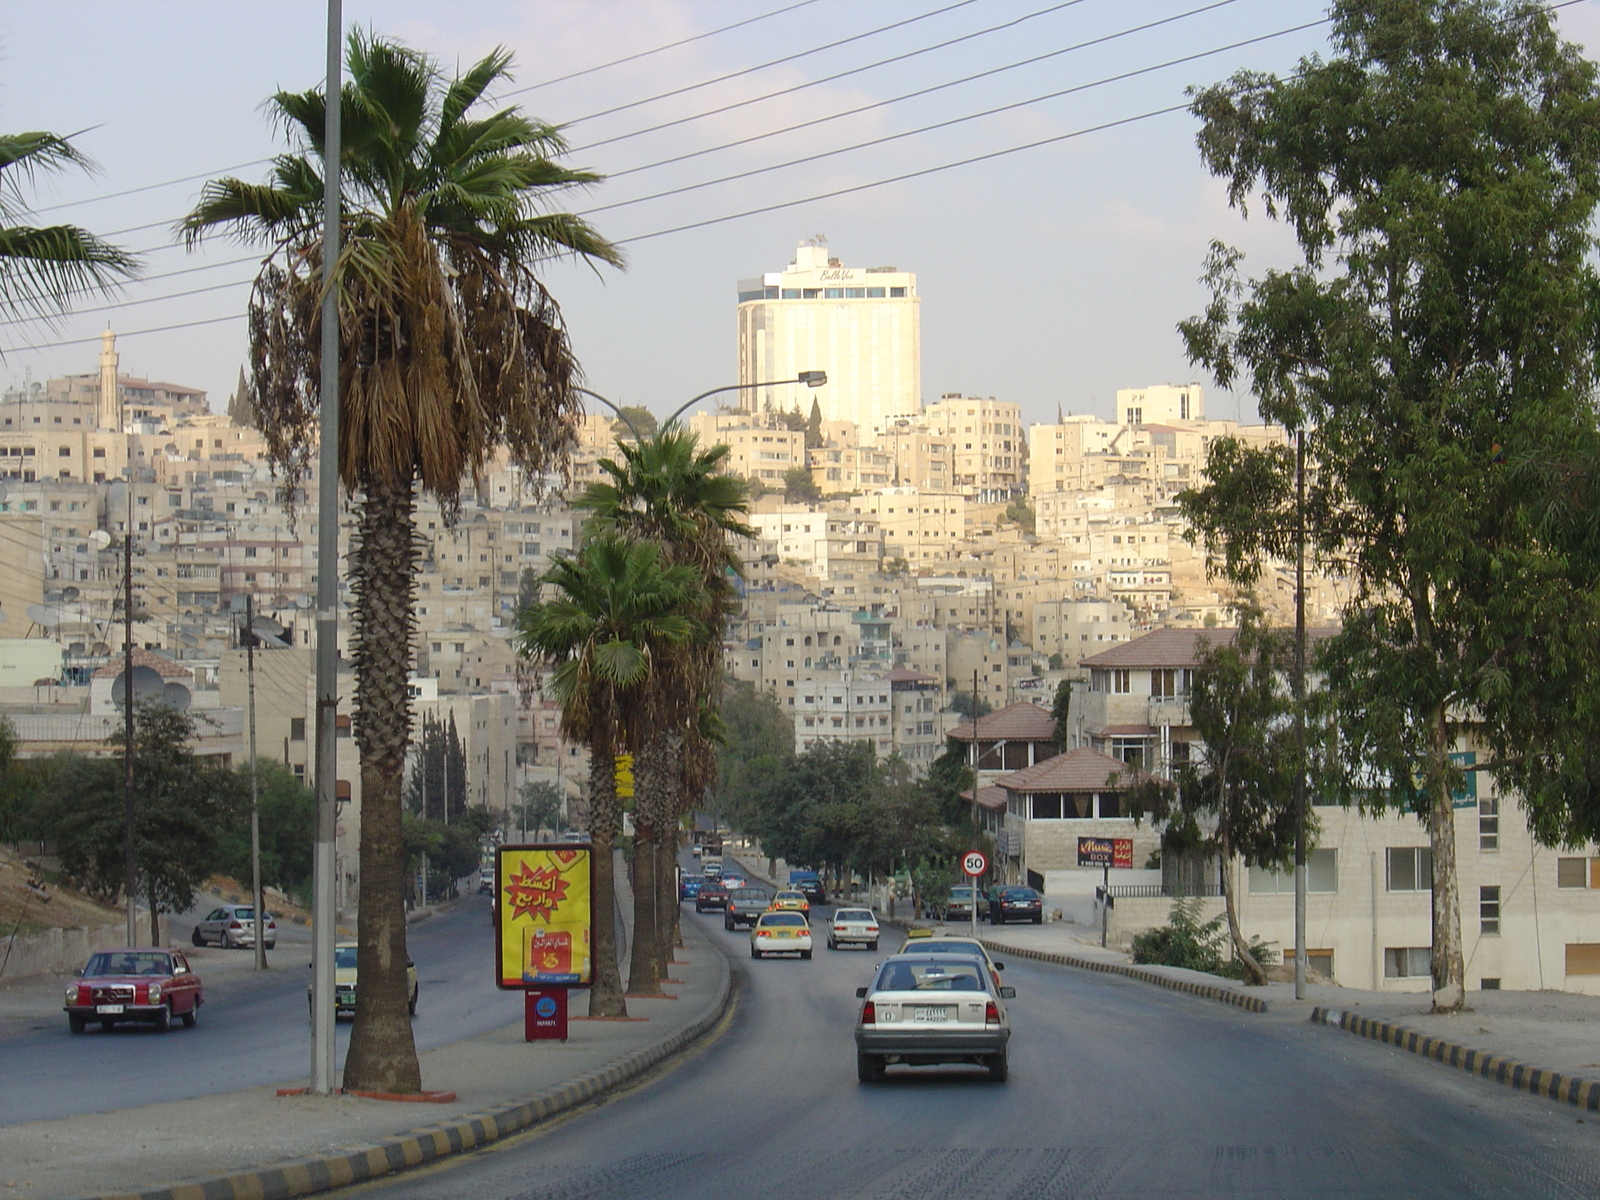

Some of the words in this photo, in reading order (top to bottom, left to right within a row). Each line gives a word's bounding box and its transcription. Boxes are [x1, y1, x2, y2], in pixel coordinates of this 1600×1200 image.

[820, 269, 841, 281] Belle
[1084, 839, 1113, 853] Music
[1090, 853, 1109, 862] BOX
[966, 858, 982, 869] 50
[515, 891, 553, 909] واربح
[884, 1012, 892, 1021] D
